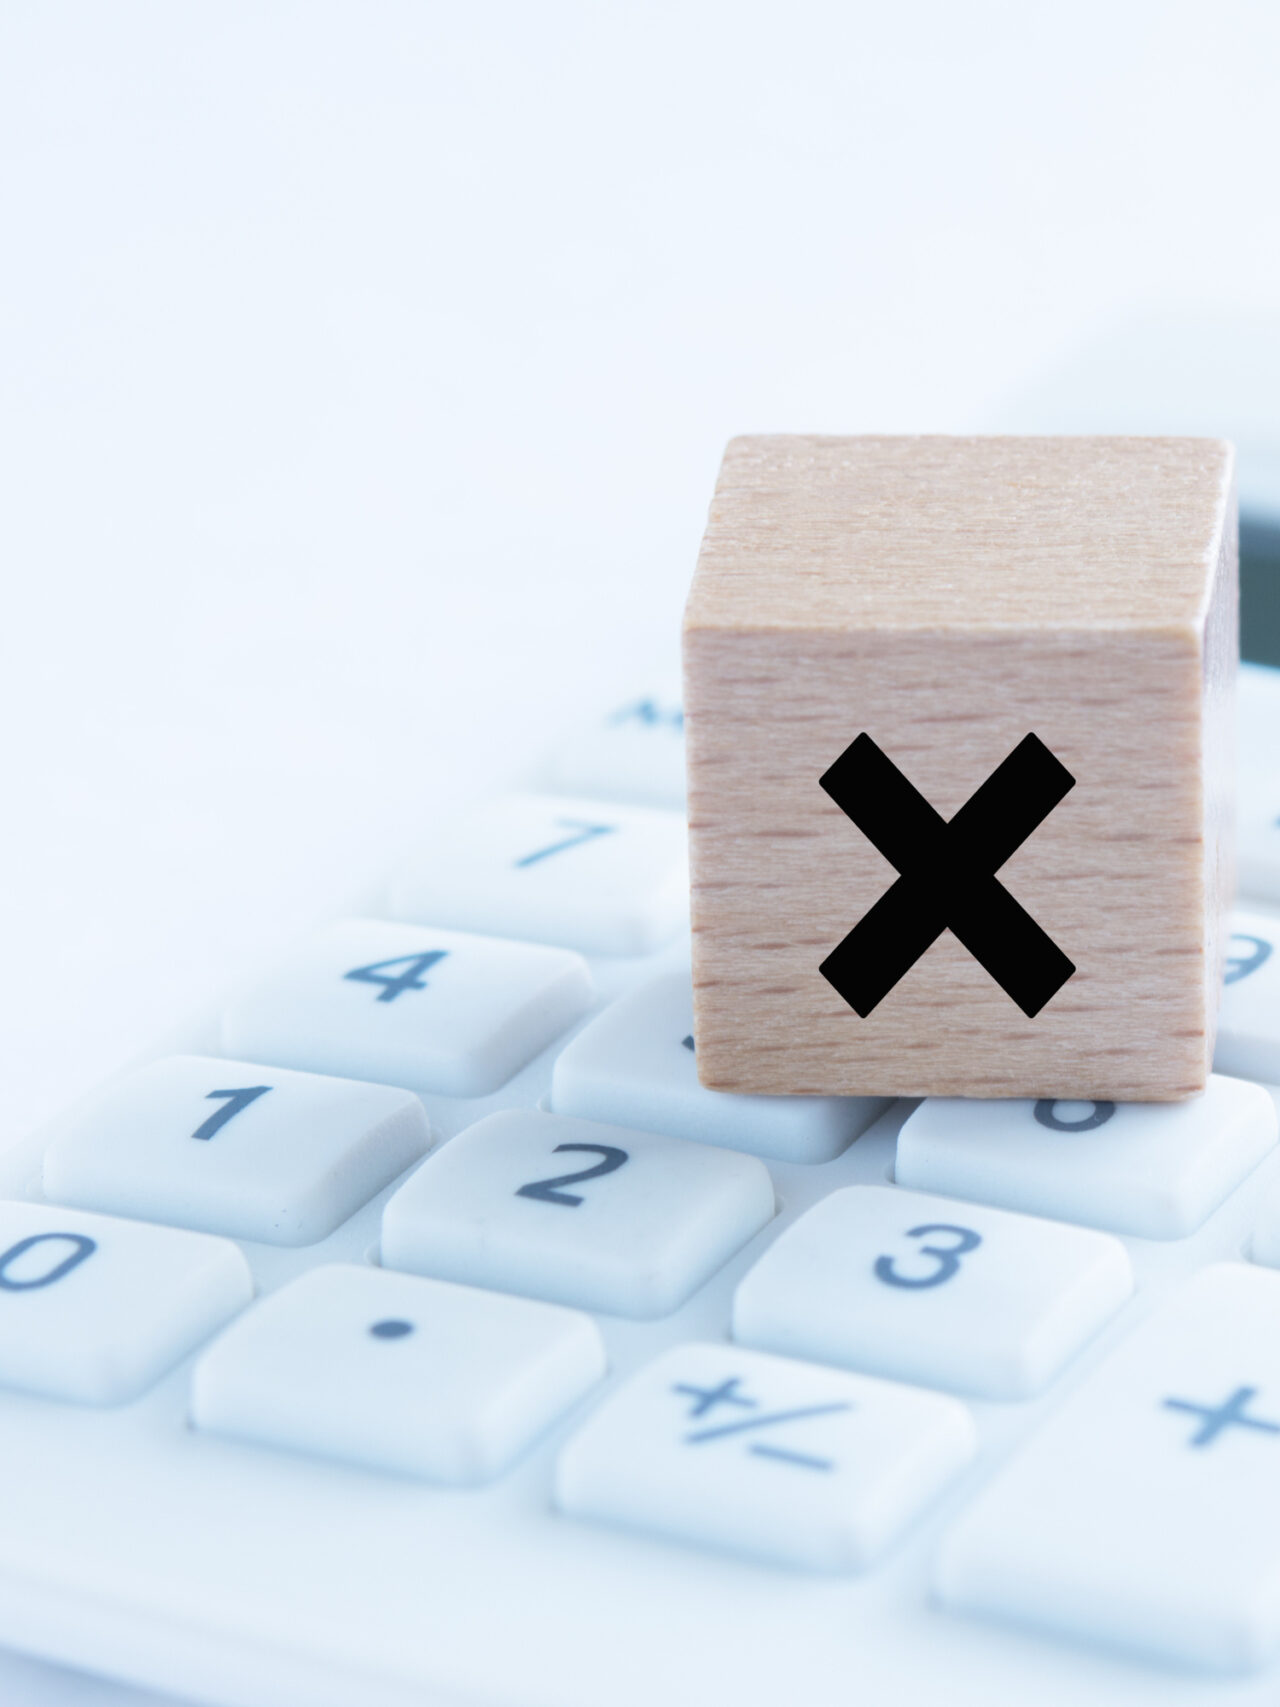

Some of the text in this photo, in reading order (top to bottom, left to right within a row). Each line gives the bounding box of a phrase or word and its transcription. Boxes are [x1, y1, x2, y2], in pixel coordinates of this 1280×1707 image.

[512, 820, 618, 870] 7
[342, 948, 450, 1004] 4
[190, 1084, 274, 1142] 1
[514, 1141, 631, 1208] 2
[0, 1231, 98, 1293] 0
[872, 1222, 983, 1292] 3
